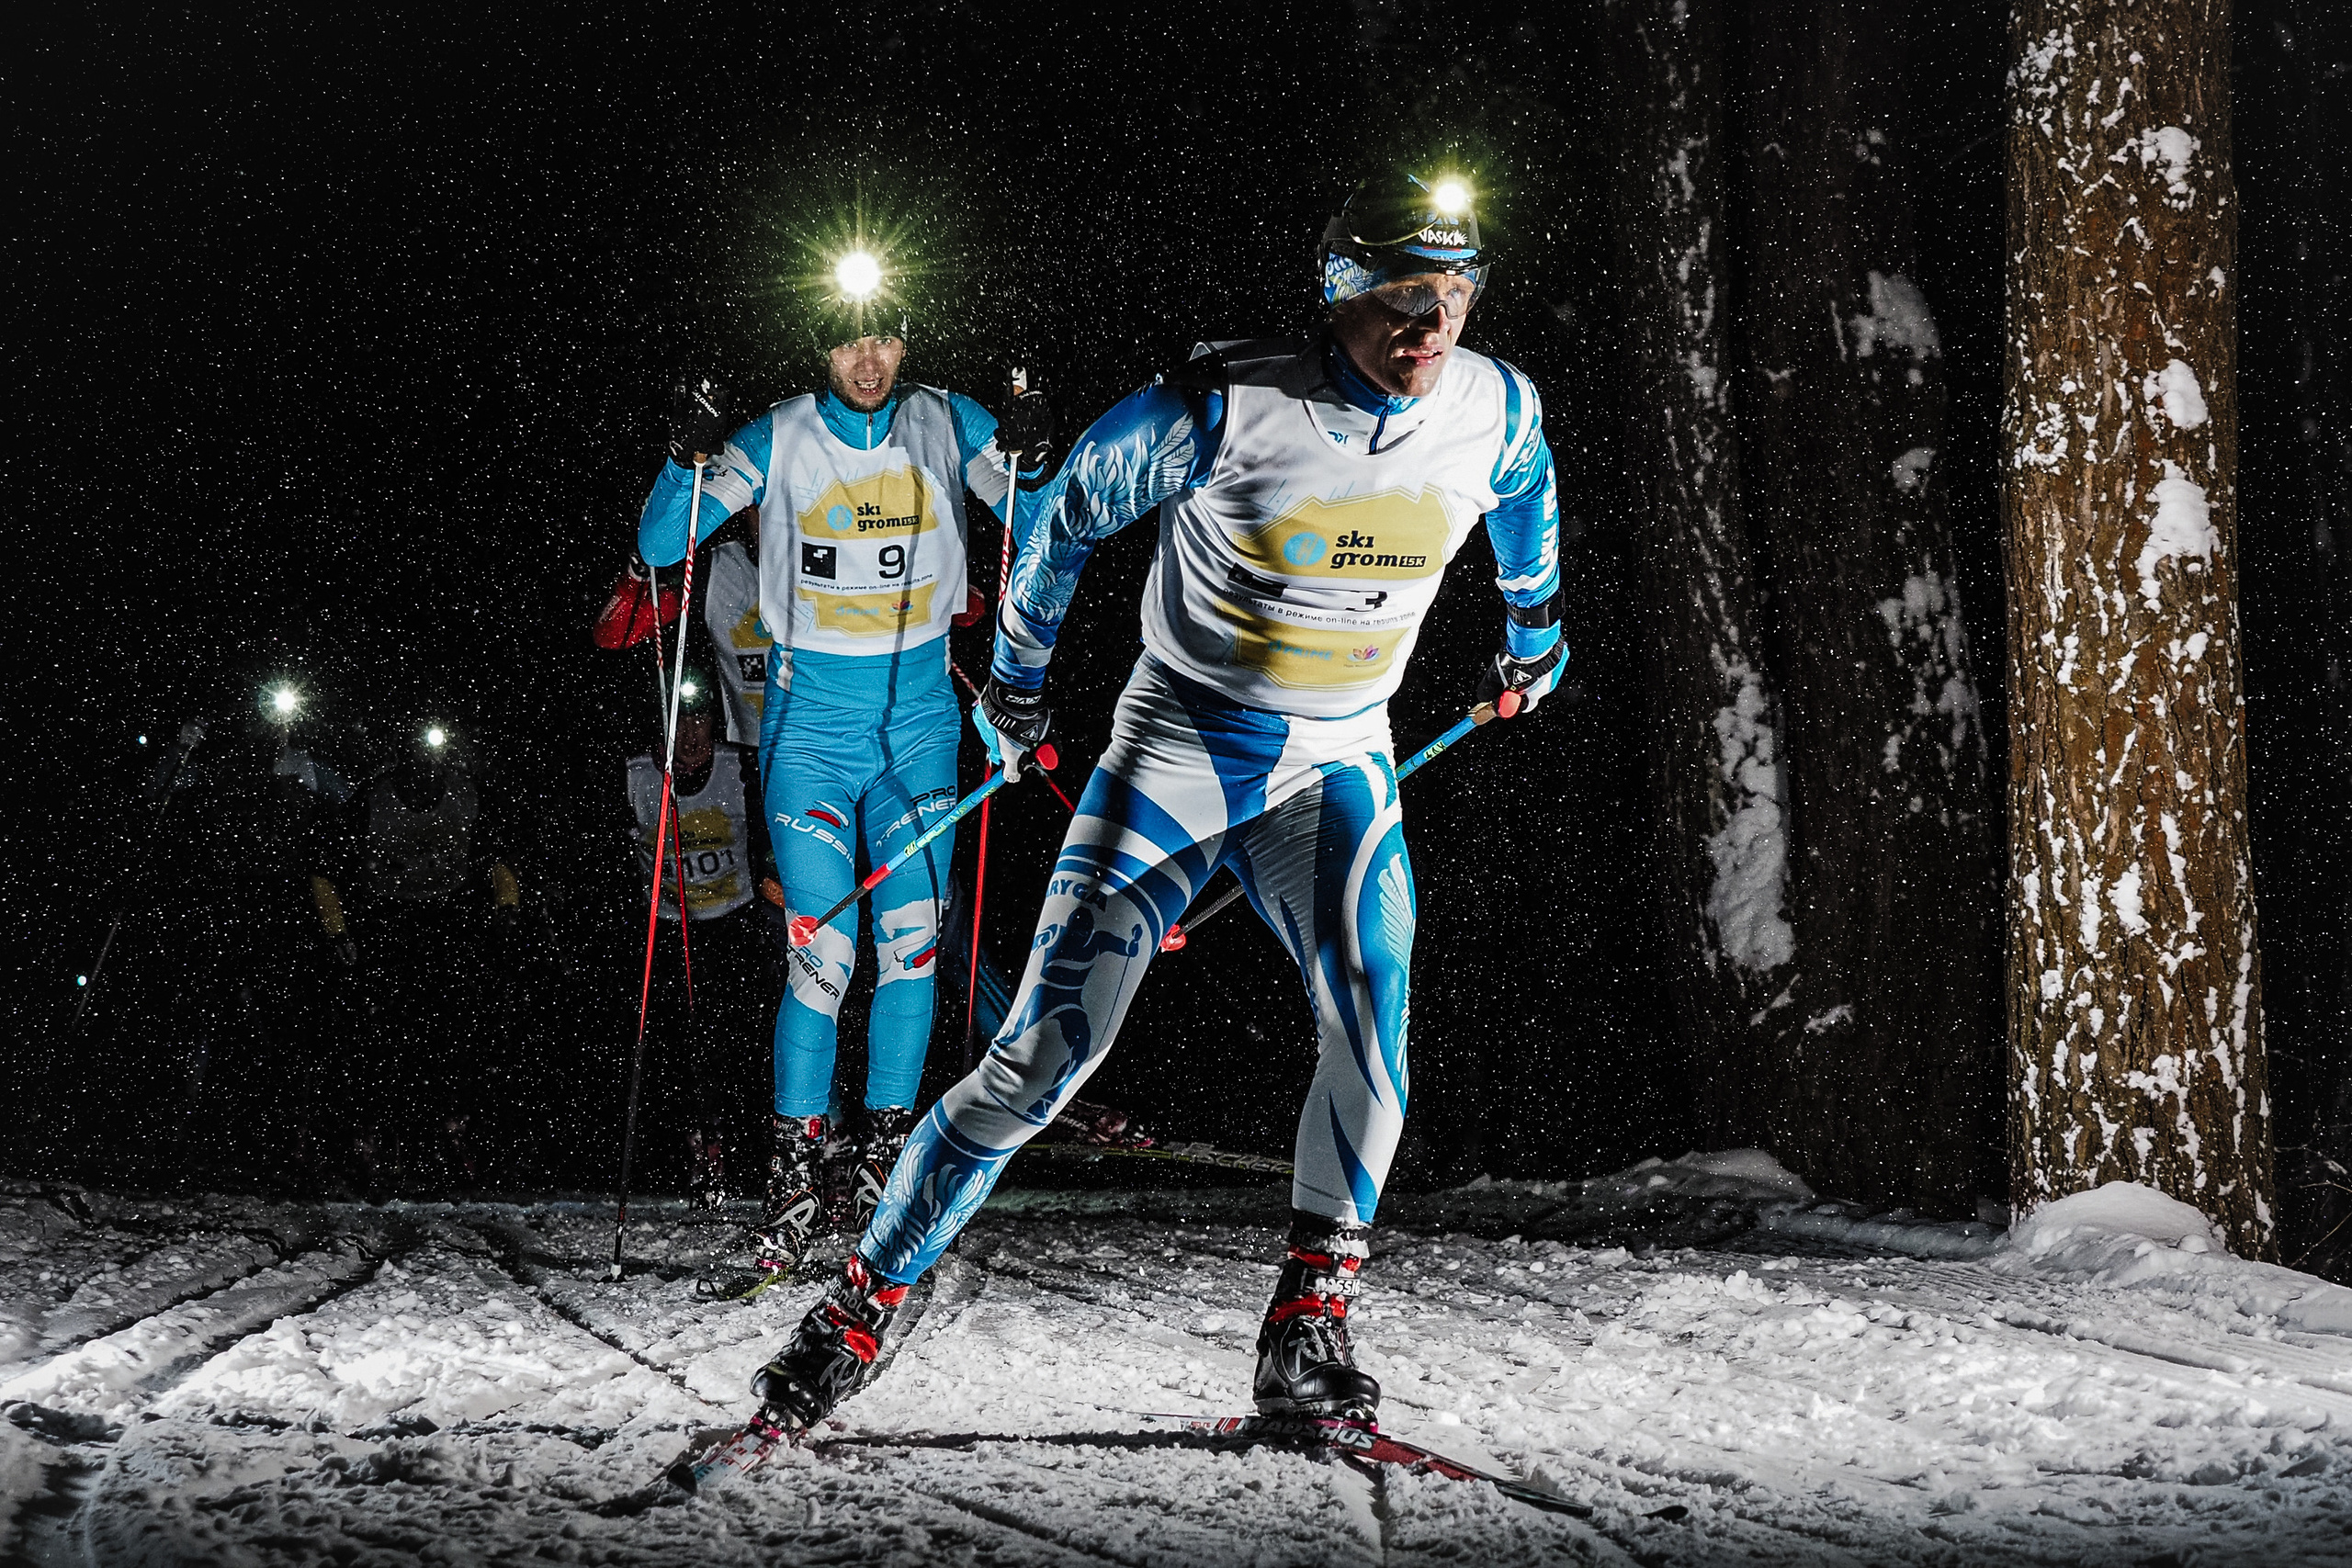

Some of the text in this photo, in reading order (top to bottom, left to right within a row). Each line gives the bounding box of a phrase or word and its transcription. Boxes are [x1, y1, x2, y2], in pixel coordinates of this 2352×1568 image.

[857, 502, 881, 516] ski
[857, 516, 901, 532] grom
[1335, 530, 1374, 548] ski
[878, 544, 906, 579] 9
[1329, 553, 1427, 570] grom 15K
[1285, 609, 1323, 623] режиме
[1325, 616, 1358, 626] on-line
[910, 785, 956, 807] PRO
[786, 944, 841, 1000] TRENER
